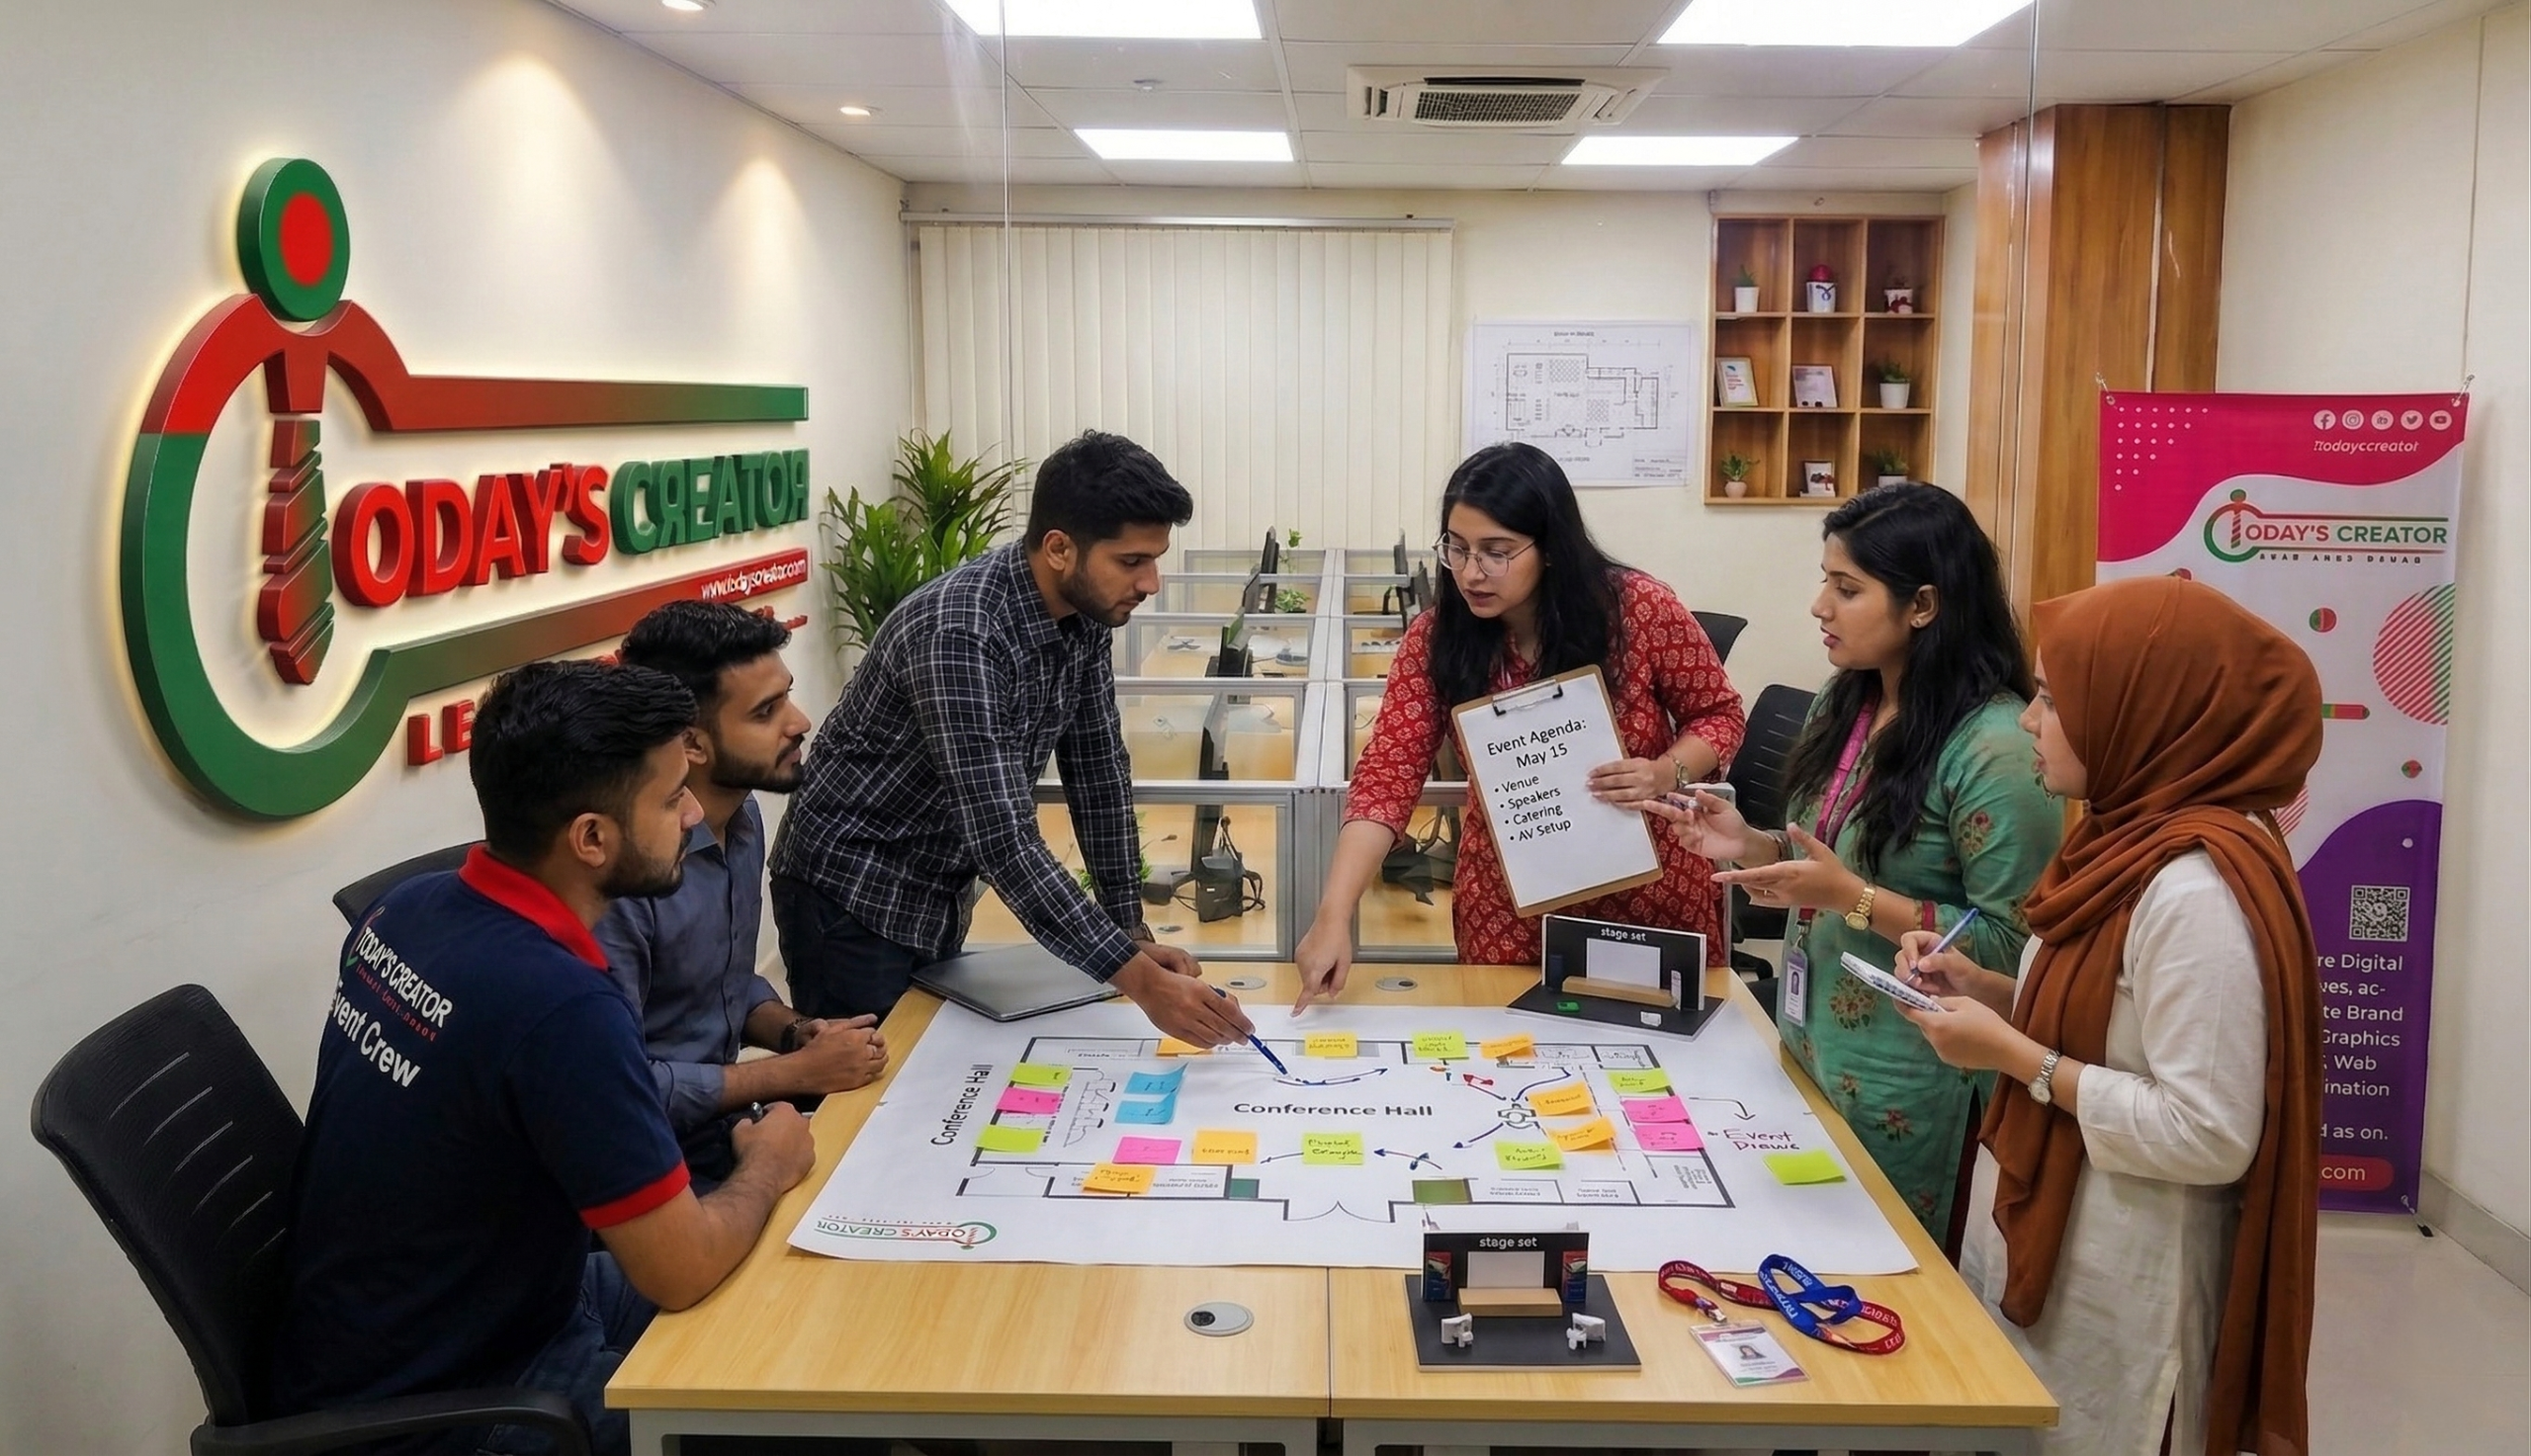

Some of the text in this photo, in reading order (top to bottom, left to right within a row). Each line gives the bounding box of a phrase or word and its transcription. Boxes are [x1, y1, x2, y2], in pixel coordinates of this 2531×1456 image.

[2337, 526, 2448, 544] CREATOR
[407, 699, 475, 766] LE
[1487, 719, 1587, 756] Event Agenda:
[1516, 743, 1568, 769] May 15
[1501, 774, 1540, 794] Venue
[1508, 787, 1561, 811] Speakers
[1513, 804, 1563, 826] Catering
[1519, 818, 1572, 842] AV Setup
[1601, 927, 1646, 942] stage set
[2317, 953, 2403, 974] re Digital
[356, 926, 398, 979] TODAY'S
[389, 962, 453, 1029] CREATOR
[2319, 982, 2386, 996] ves, ac-
[2322, 1004, 2403, 1021] te Brand
[333, 979, 369, 1042] vent
[360, 1021, 421, 1088] Crew
[2323, 1029, 2400, 1048] Graphics
[2334, 1055, 2377, 1071] Web
[2324, 1078, 2390, 1096] ination
[930, 1064, 994, 1146] Conference Hall
[1234, 1102, 1433, 1117] Conference Hall
[1723, 1128, 1793, 1142] Event
[2332, 1126, 2355, 1139] as
[2360, 1127, 2389, 1141] on.
[2321, 1166, 2366, 1181] com
[817, 1220, 897, 1236] CREATOR
[1479, 1236, 1537, 1249] stage set
